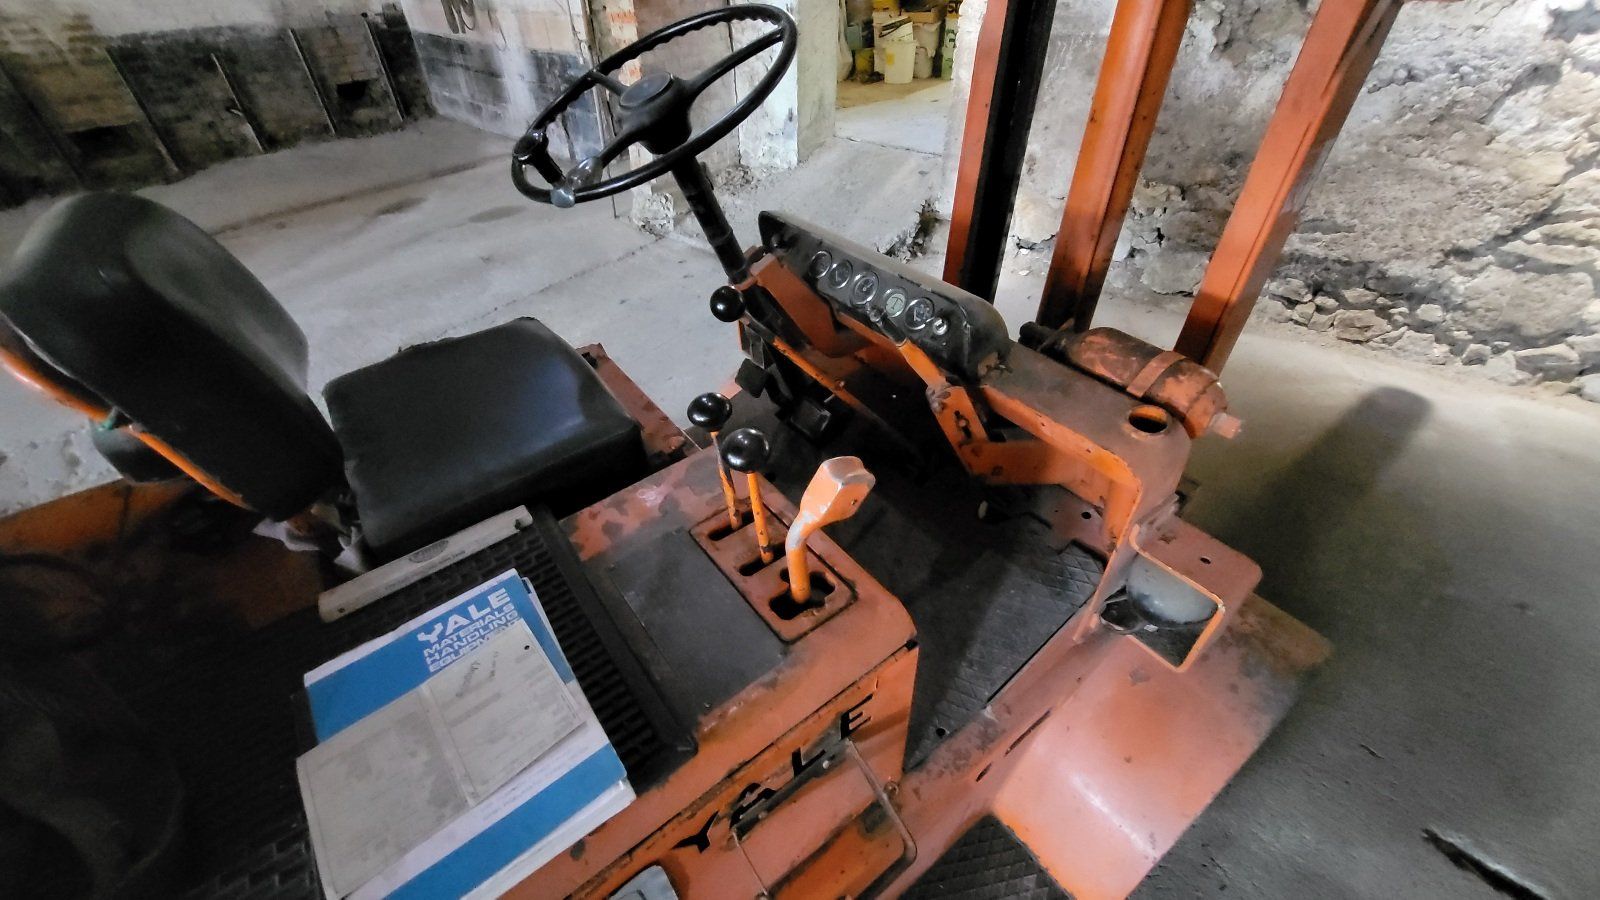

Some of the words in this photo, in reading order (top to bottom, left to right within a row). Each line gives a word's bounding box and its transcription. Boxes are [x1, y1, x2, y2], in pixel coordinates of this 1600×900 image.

[417, 588, 510, 642] YALE
[424, 603, 514, 657] MATERIALS
[426, 610, 518, 665] HANDLING
[672, 694, 873, 853] YALE
